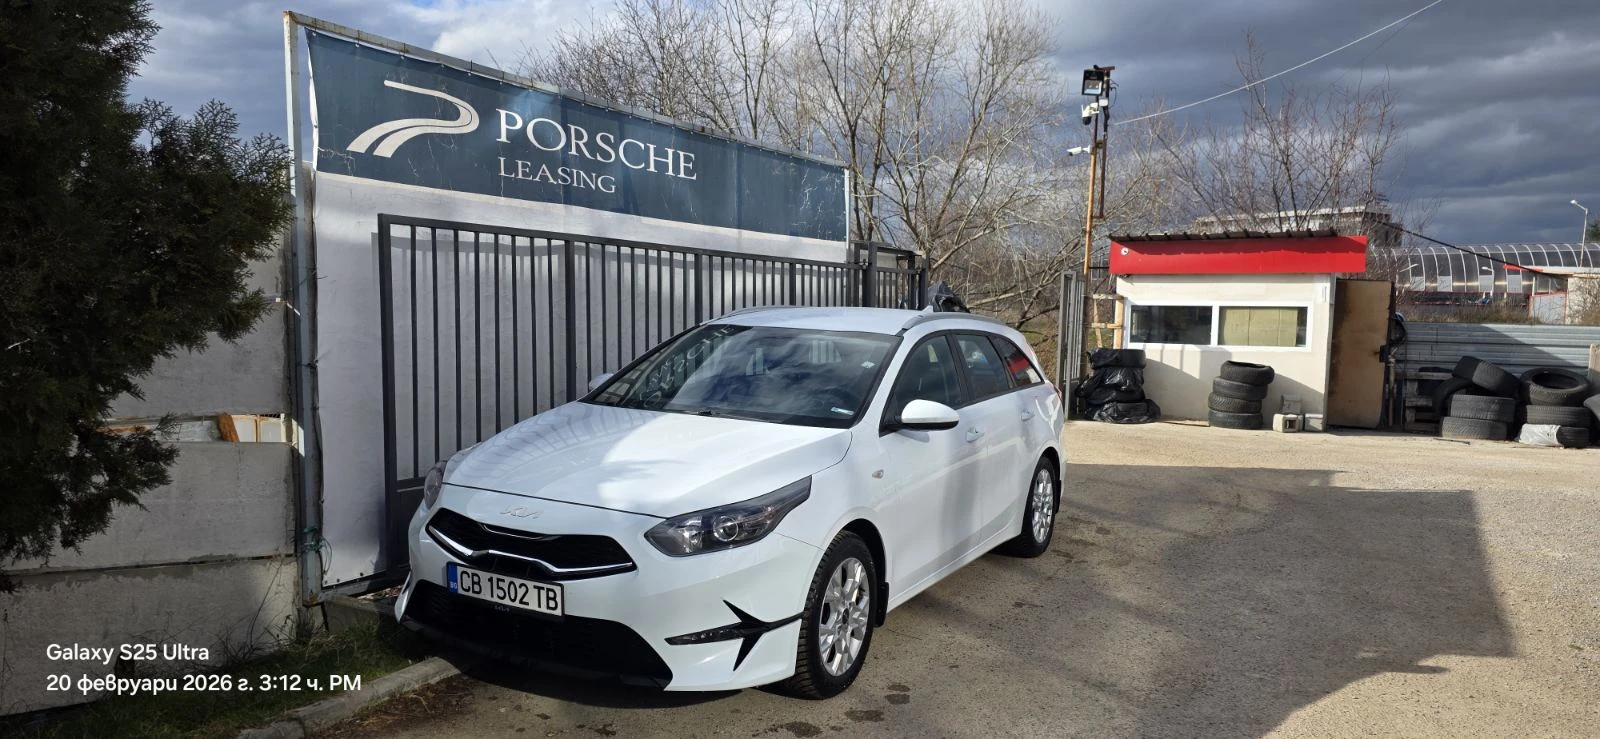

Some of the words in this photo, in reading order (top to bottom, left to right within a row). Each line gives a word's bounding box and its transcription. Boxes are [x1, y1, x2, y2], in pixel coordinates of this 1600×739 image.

[495, 108, 697, 182] PORSCHE
[498, 156, 617, 194] LEASING
[460, 570, 482, 595] CB
[487, 576, 530, 606] 1502
[533, 585, 559, 611] TB
